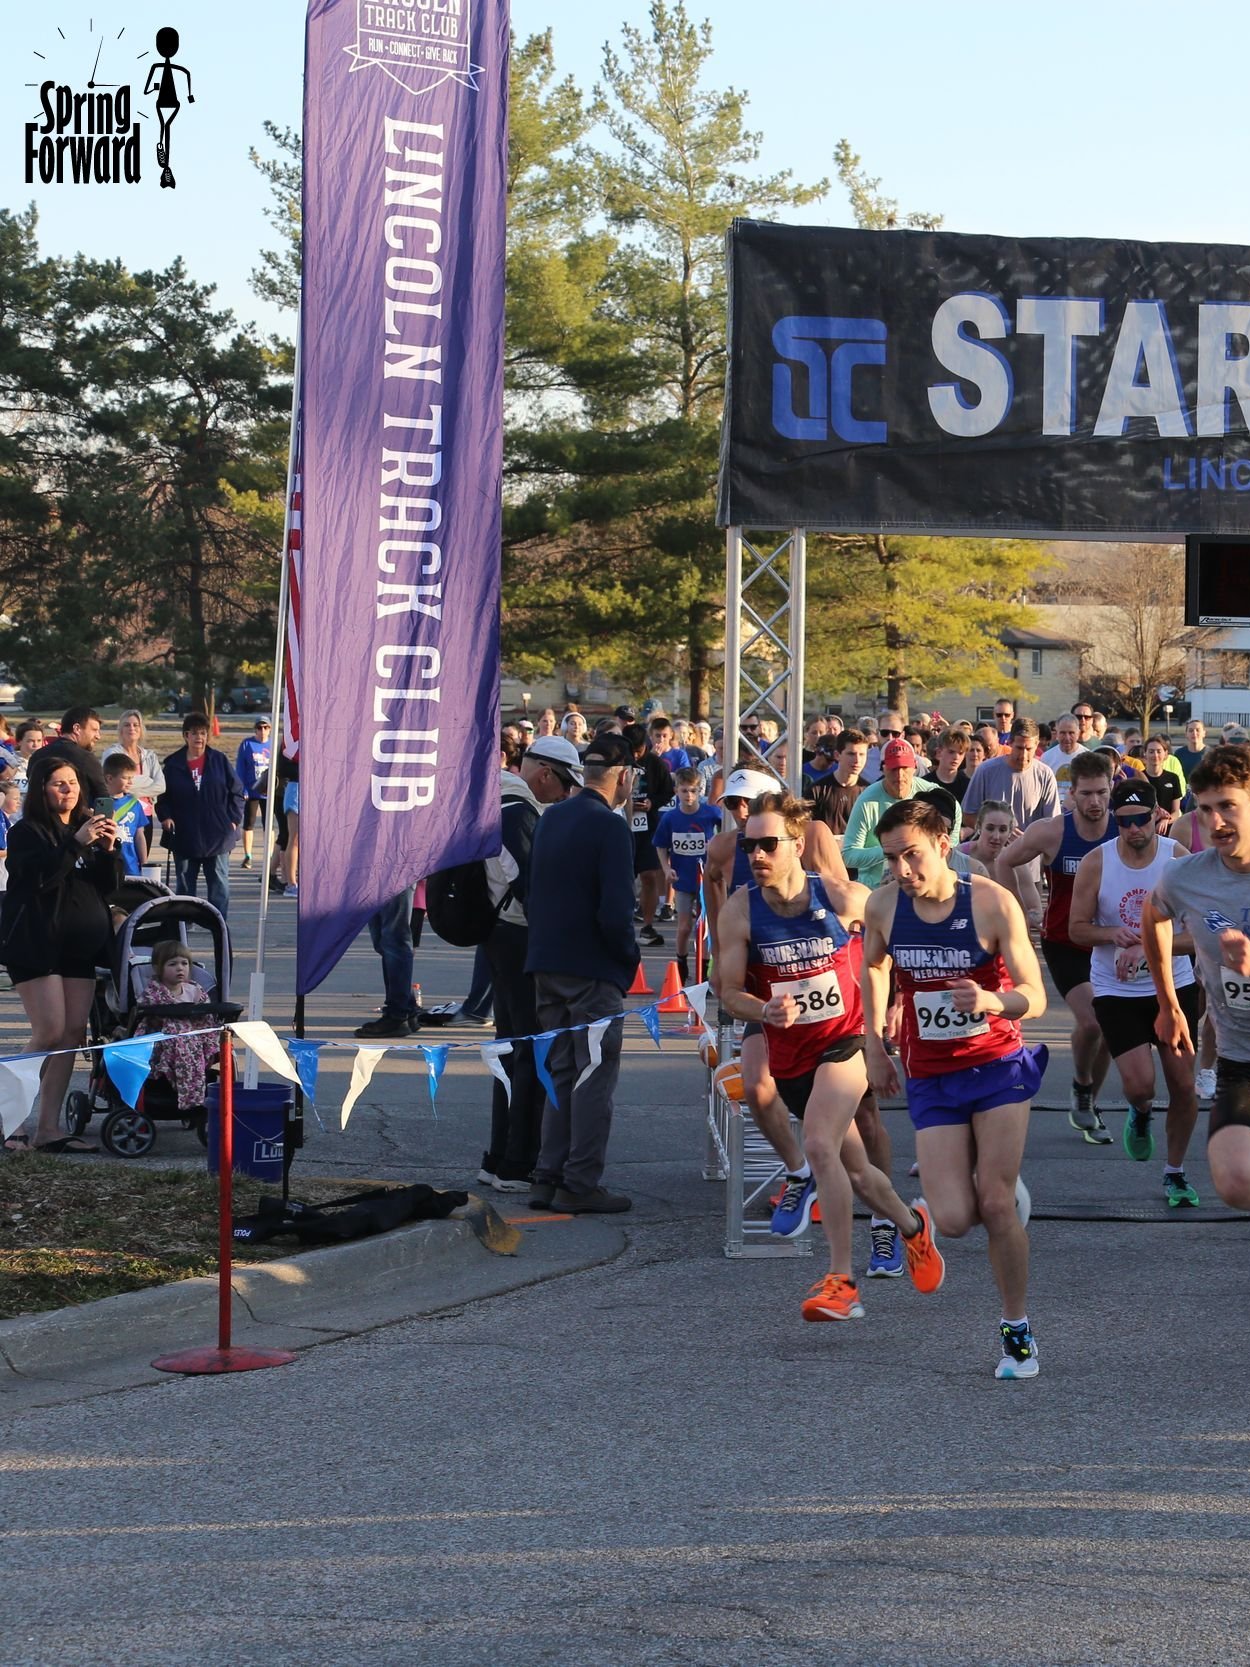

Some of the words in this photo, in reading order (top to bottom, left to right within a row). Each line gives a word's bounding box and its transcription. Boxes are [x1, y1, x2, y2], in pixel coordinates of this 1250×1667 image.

[364, 4, 417, 32] TRACK
[421, 13, 458, 38] CLUB
[368, 37, 384, 53] RUN
[390, 41, 421, 58] CONNECT
[425, 46, 441, 62] GIVE
[442, 48, 458, 65] BACK
[383, 115, 444, 385] LINCOLN
[376, 404, 444, 621] TRACK
[370, 644, 441, 813] CLUB
[633, 816, 647, 827] 02
[673, 839, 705, 851] 9633
[779, 956, 829, 974] NEBRASKA
[792, 985, 841, 1014] 586
